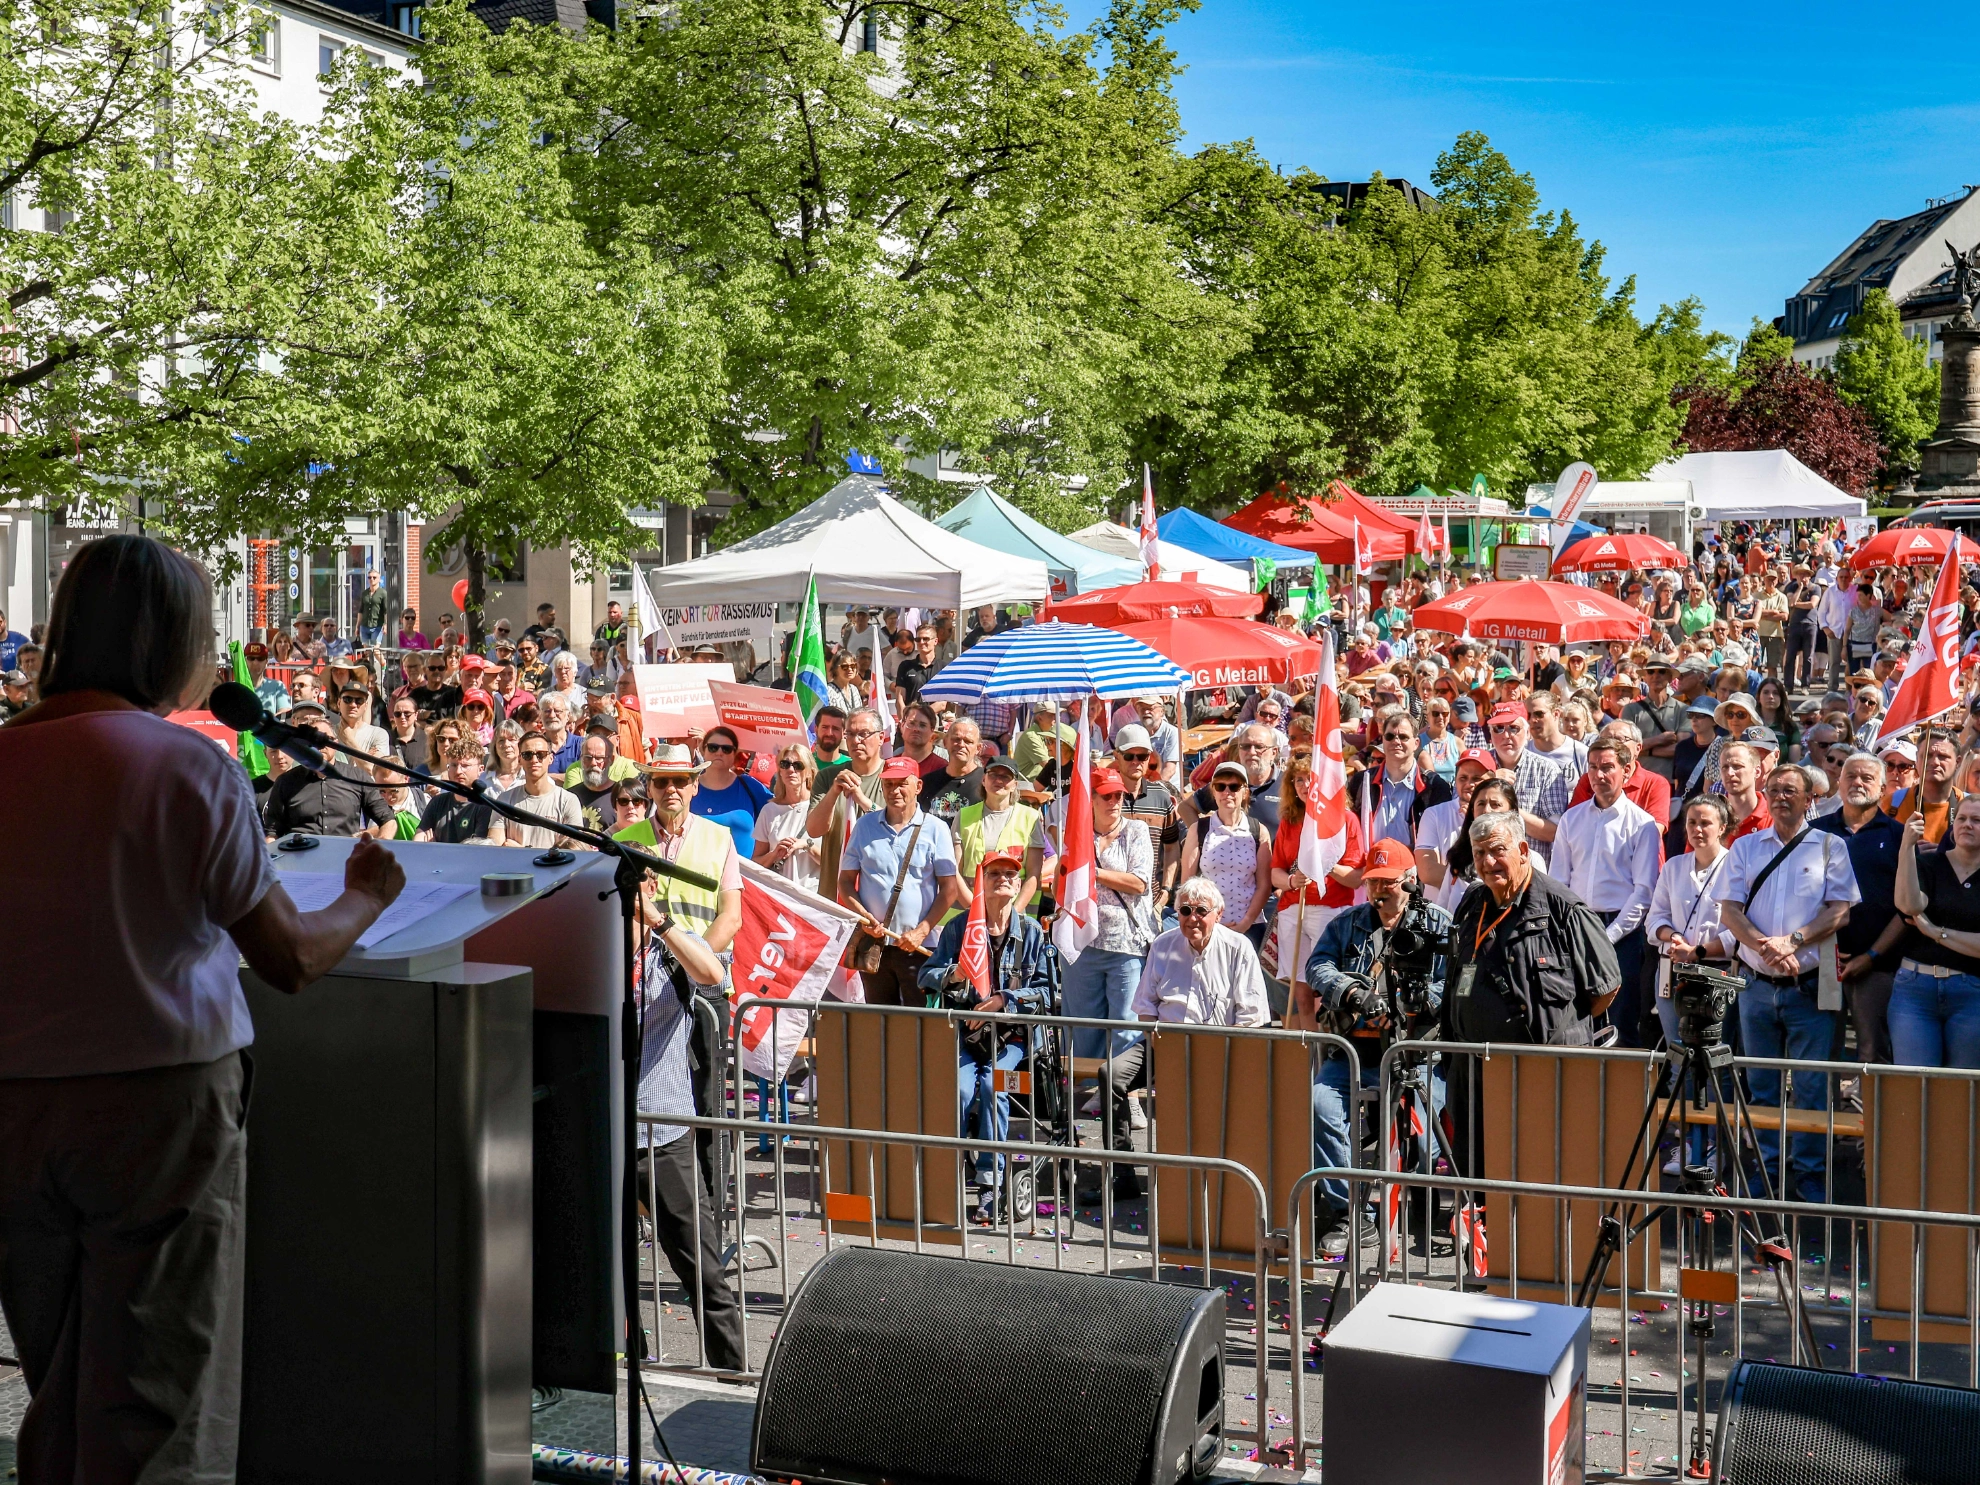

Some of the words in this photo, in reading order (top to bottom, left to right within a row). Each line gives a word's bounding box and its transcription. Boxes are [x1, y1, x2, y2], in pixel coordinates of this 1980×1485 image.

[66, 519, 85, 528] JEANS
[86, 520, 99, 528] AND
[100, 519, 119, 529] MORE
[661, 608, 682, 627] KEIN
[720, 602, 773, 621] RASSISMUS
[681, 632, 698, 642] Bündnis
[705, 629, 729, 640] Demokratie
[729, 629, 737, 637] und
[1483, 623, 1500, 637] IG
[1504, 624, 1547, 640] Metall
[1191, 669, 1211, 687] IG
[1214, 665, 1269, 684] Metall
[724, 712, 795, 725] #TARIFTREUEGESETZ
